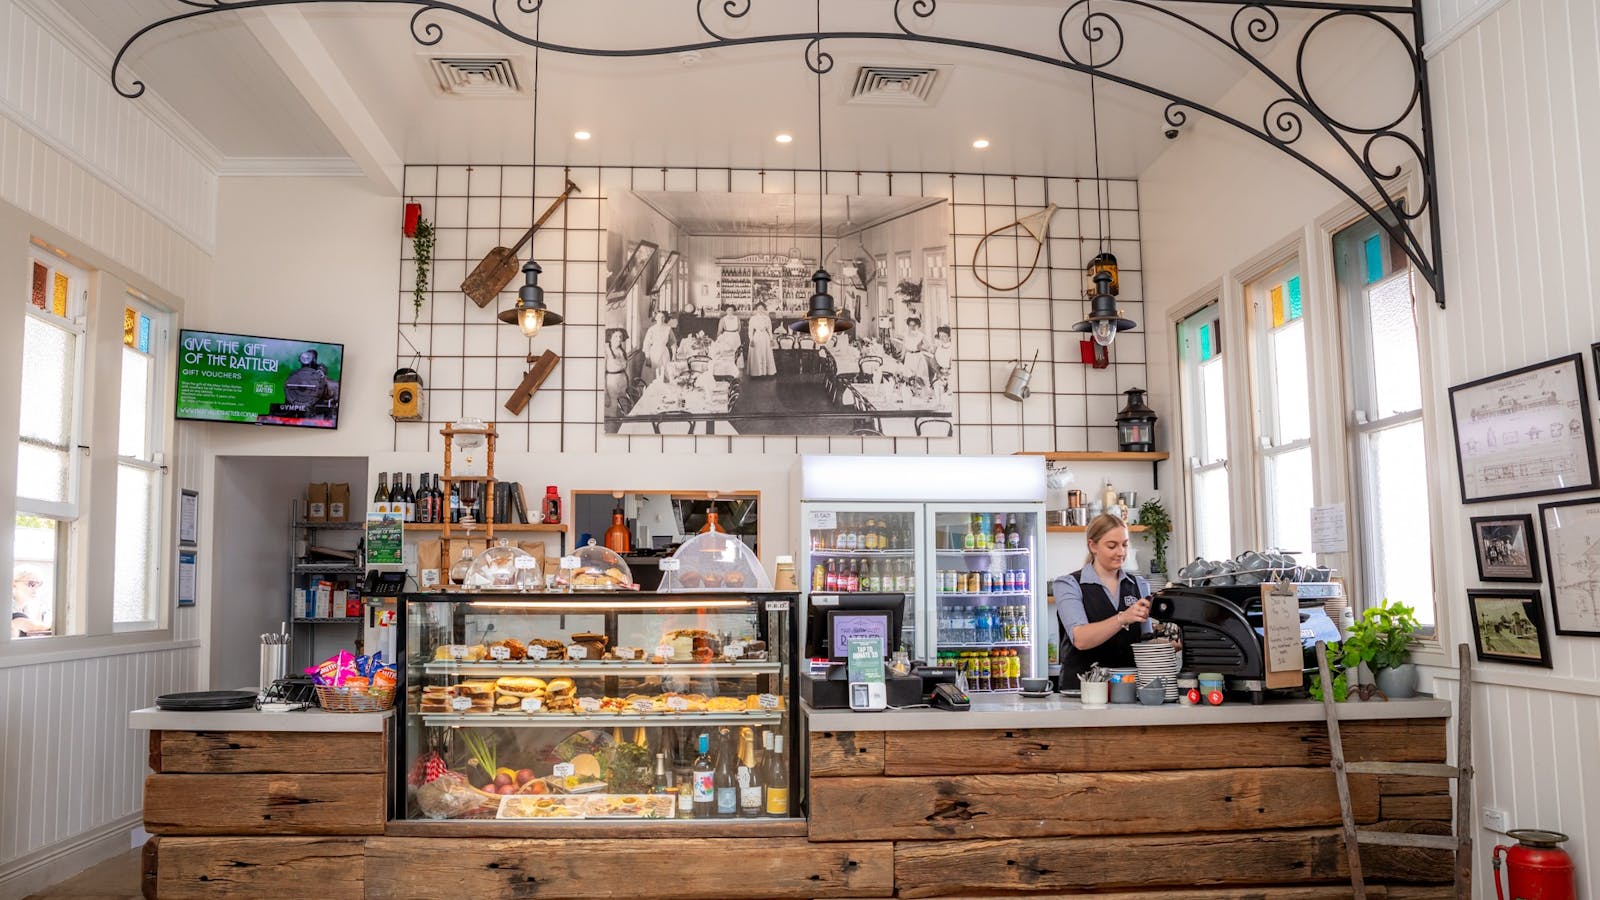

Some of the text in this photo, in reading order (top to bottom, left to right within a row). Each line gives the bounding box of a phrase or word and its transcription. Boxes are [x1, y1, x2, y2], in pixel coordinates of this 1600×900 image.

[184, 337, 267, 357] GIVE THE GIFT
[184, 352, 203, 364] OF
[207, 353, 227, 367] THE
[201, 370, 242, 379] VOUCHERS
